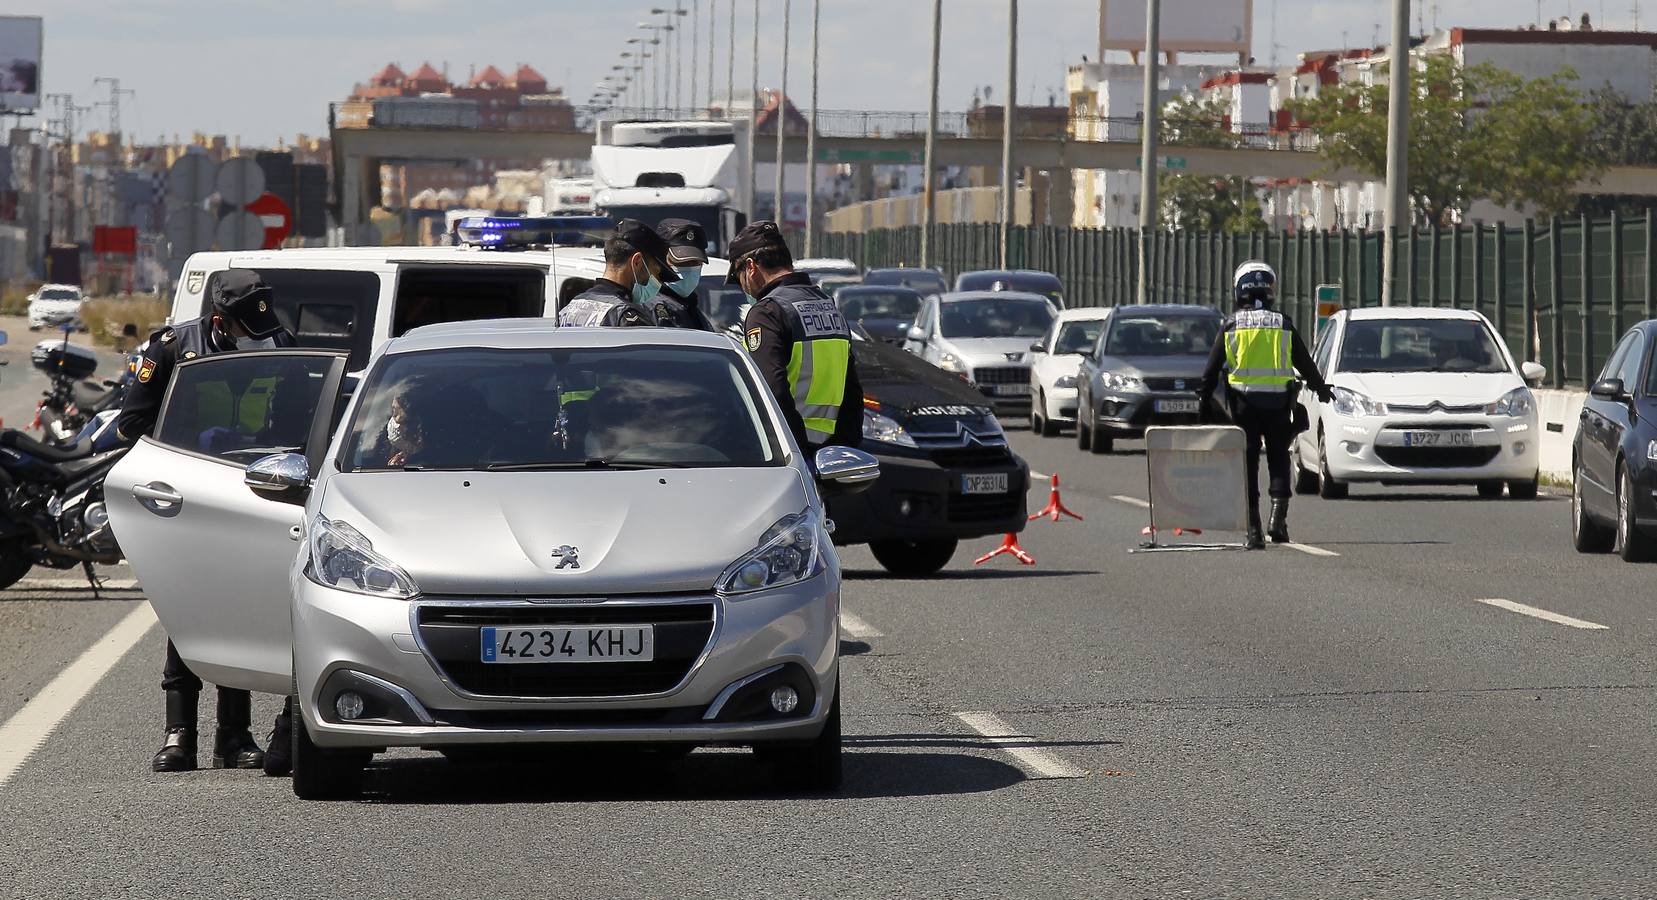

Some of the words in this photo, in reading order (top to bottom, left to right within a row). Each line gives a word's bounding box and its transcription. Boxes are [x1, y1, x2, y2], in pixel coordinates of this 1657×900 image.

[1241, 282, 1270, 290] POLICIA
[1237, 317, 1281, 327] POLICIA
[500, 630, 576, 658] 4234
[587, 629, 644, 657] KHJ
